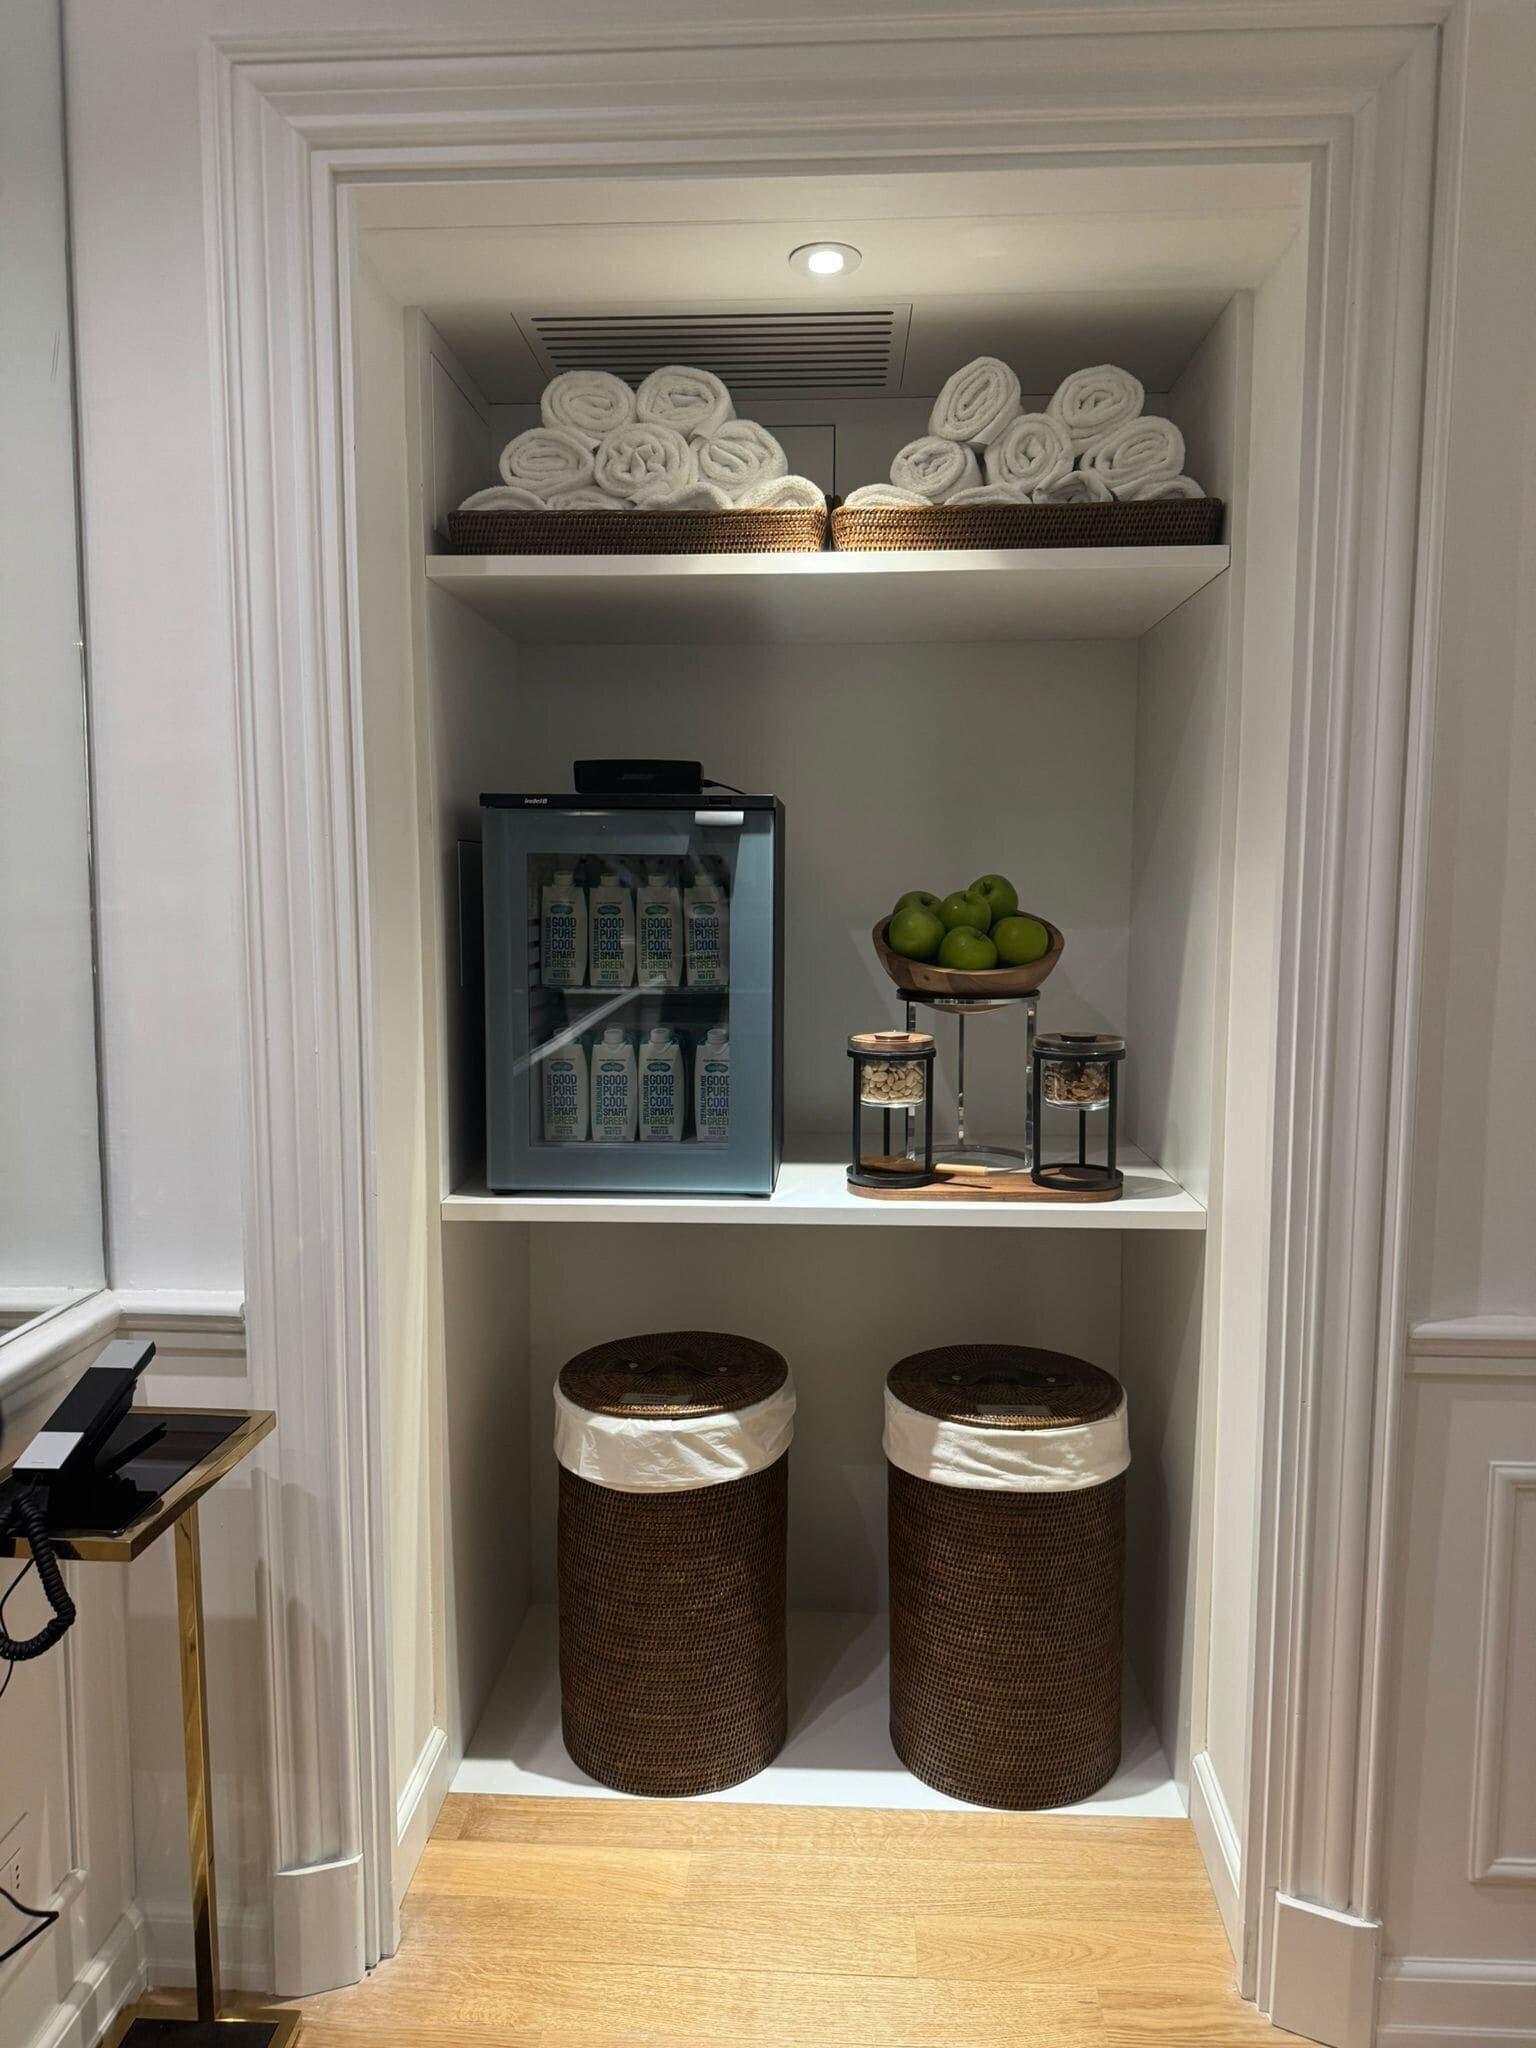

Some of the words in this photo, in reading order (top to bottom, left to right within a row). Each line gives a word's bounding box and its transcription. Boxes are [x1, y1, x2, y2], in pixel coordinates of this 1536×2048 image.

[552, 917, 576, 927] GOOD
[600, 918, 624, 928] GOOD
[647, 918, 672, 928] GOOD
[695, 918, 720, 928] GOOD
[552, 928, 576, 938] PURE
[600, 929, 624, 939] PURE
[647, 929, 672, 939] PURE
[695, 929, 720, 939] PURE
[552, 939, 576, 950] COOL
[600, 940, 624, 950] COOL
[647, 940, 672, 950] COOL
[695, 940, 720, 950] COOL
[552, 960, 576, 968] GREEN
[600, 961, 624, 969] GREEN
[647, 961, 672, 969] GREEN
[695, 961, 720, 969] GREEN
[553, 1074, 577, 1085] GOOD
[603, 1075, 628, 1085] GOOD
[650, 1075, 674, 1085] GOOD
[553, 1085, 577, 1095] PURE
[603, 1086, 628, 1096] PURE
[650, 1086, 674, 1096] PURE
[553, 1096, 577, 1106] COOL
[603, 1097, 628, 1107] COOL
[650, 1097, 674, 1107] COOL
[553, 1107, 577, 1115] SMART
[603, 1108, 628, 1116] SMART
[650, 1108, 674, 1116] SMART
[553, 1116, 577, 1125] GREEN
[603, 1117, 628, 1125] GREEN
[650, 1117, 674, 1125] GREEN
